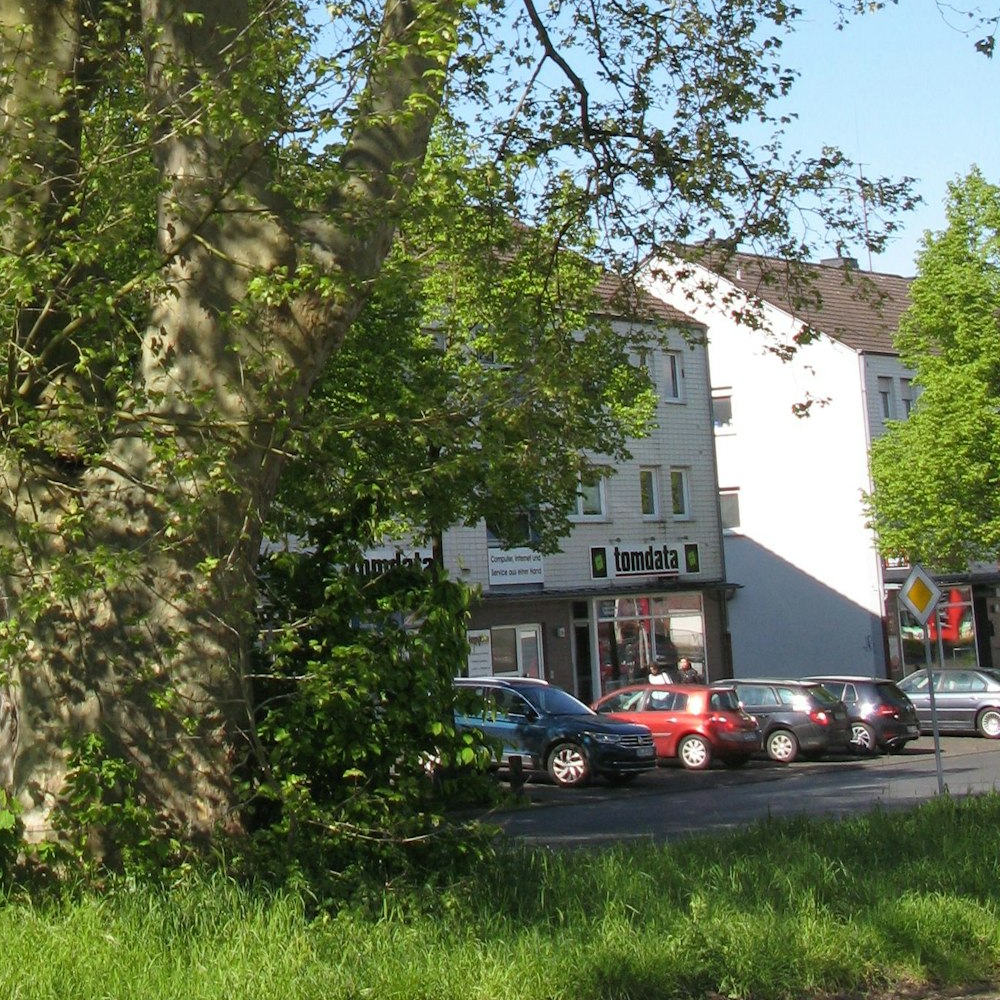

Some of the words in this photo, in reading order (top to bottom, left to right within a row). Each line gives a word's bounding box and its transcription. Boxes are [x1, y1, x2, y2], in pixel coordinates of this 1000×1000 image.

[613, 545, 679, 572] tomdata
[491, 568, 508, 577] Service
[530, 567, 542, 575] Hand
